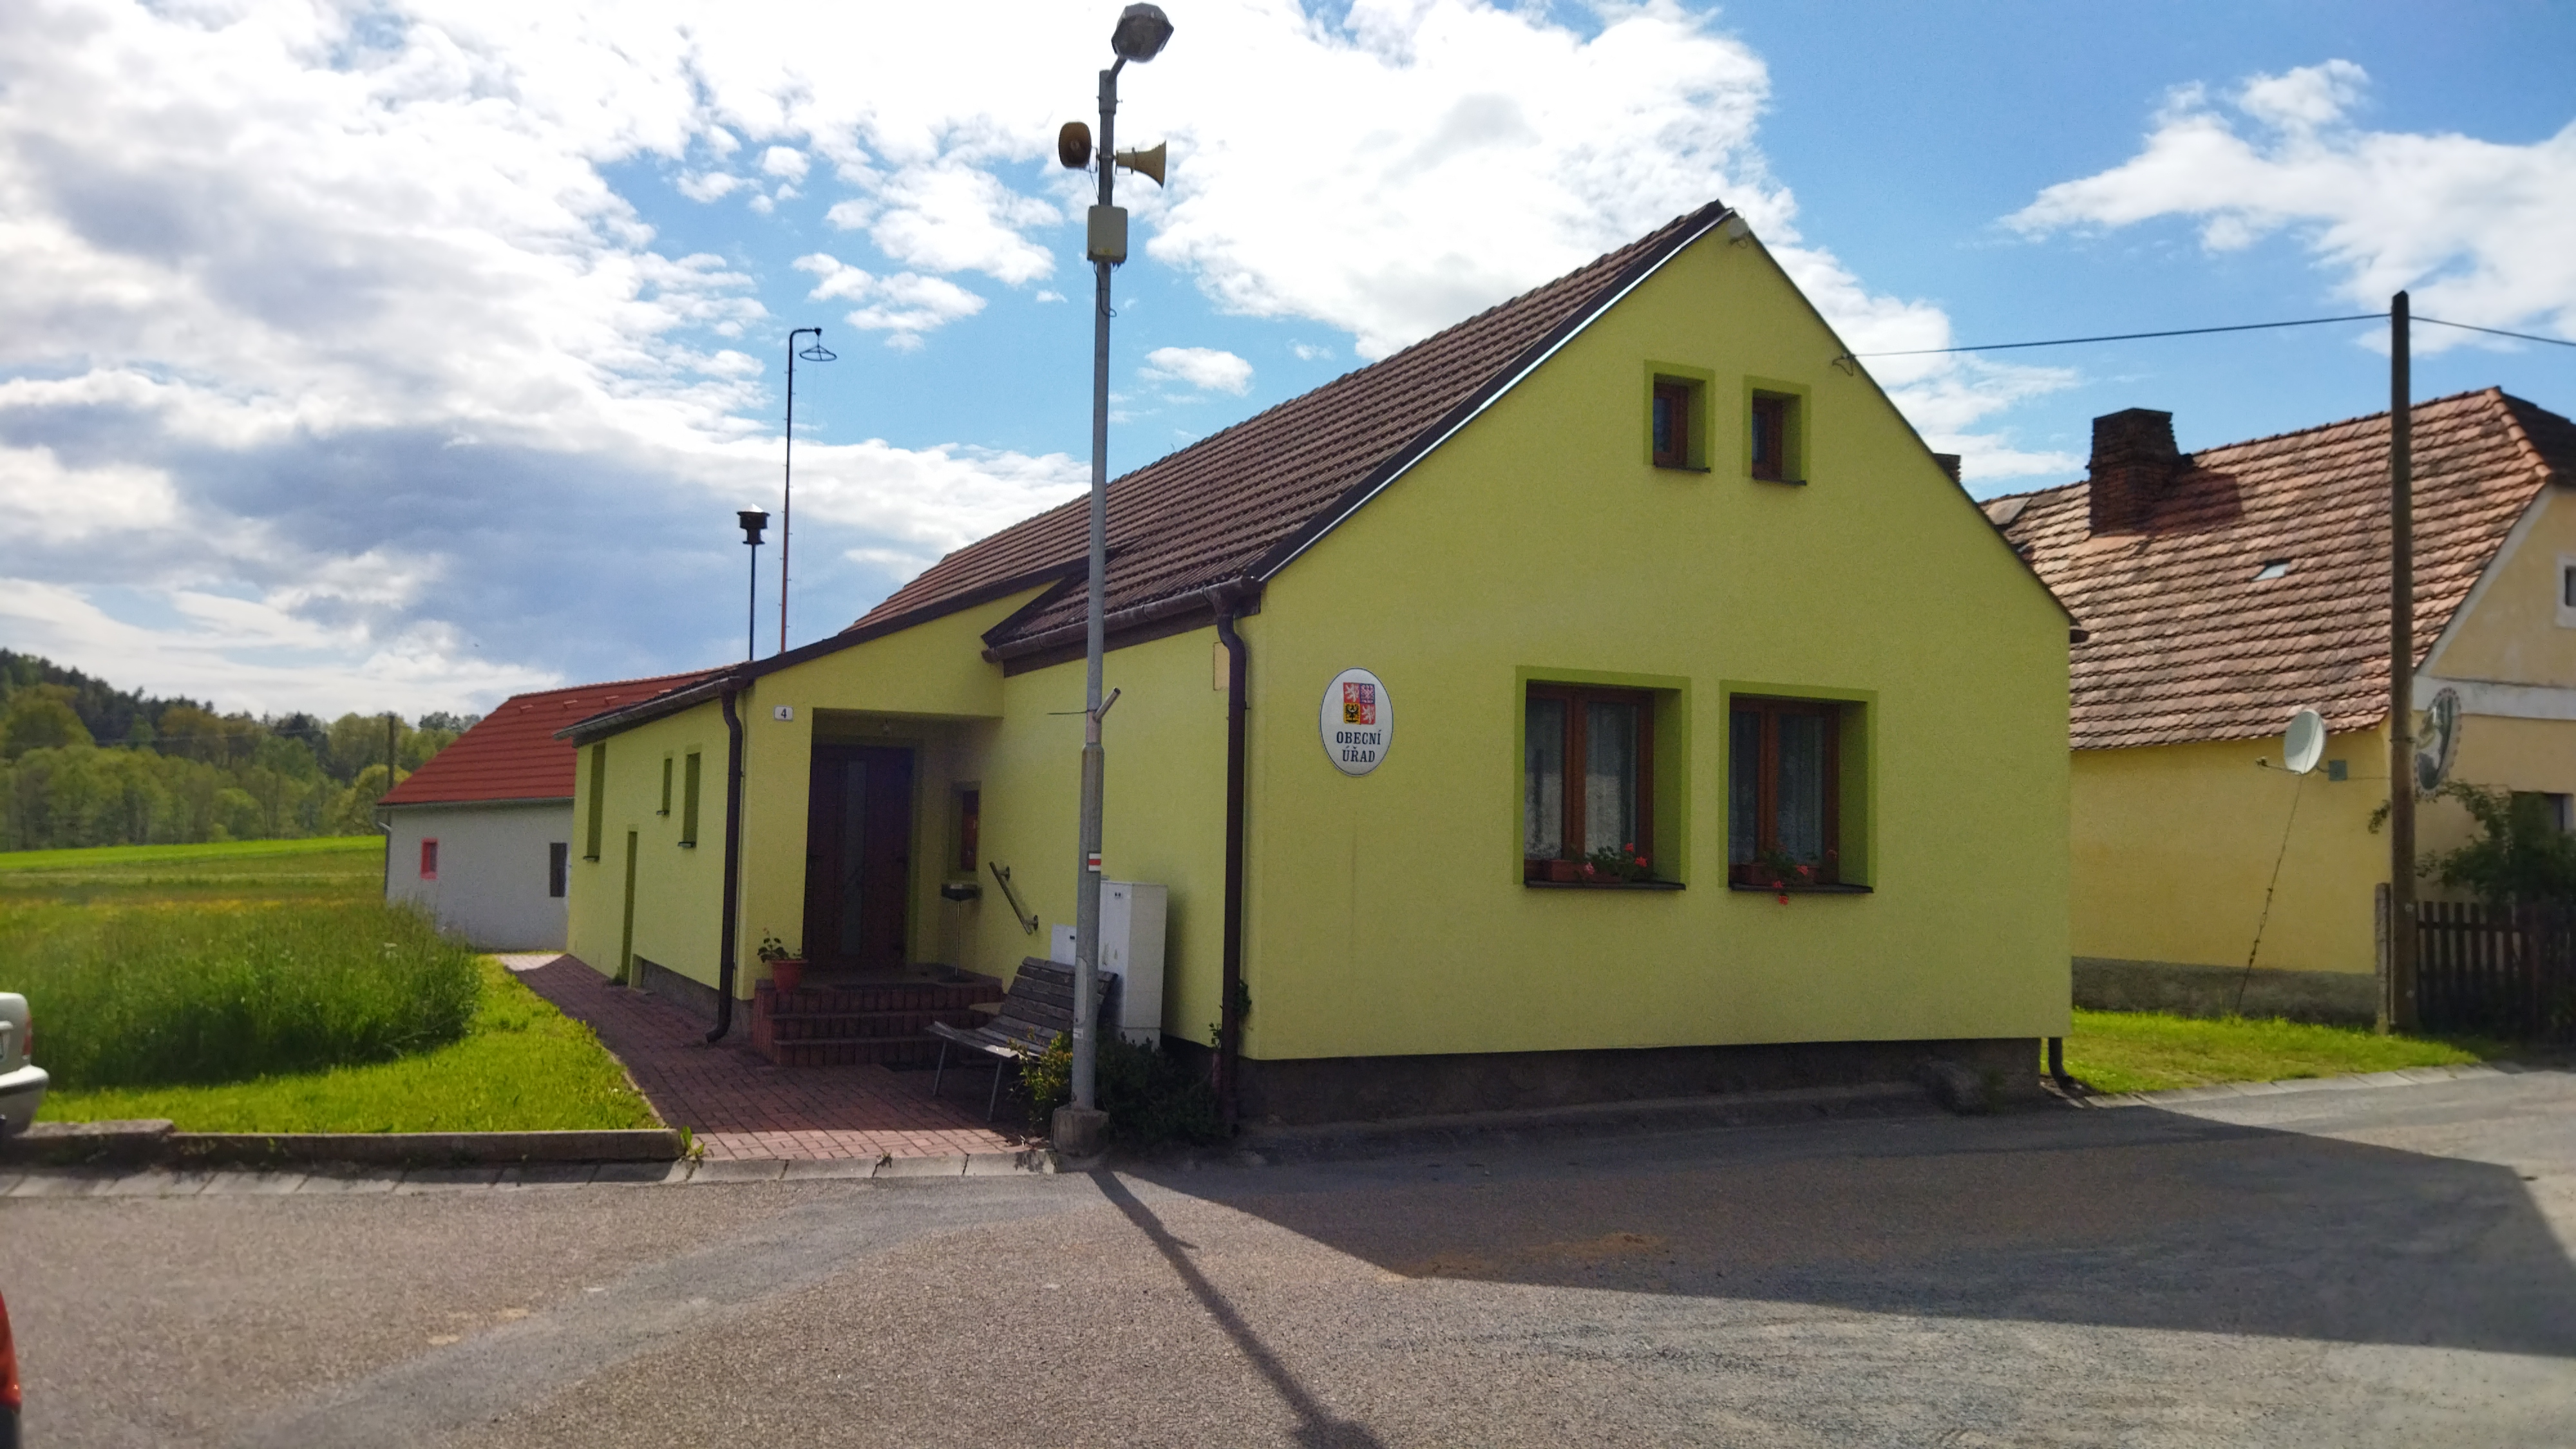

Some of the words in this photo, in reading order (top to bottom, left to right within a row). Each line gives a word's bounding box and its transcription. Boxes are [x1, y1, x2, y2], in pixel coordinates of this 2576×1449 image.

[781, 708, 787, 719] 4
[1336, 730, 1381, 745] OBECNÍ
[1342, 746, 1376, 762] ÚŘAD
